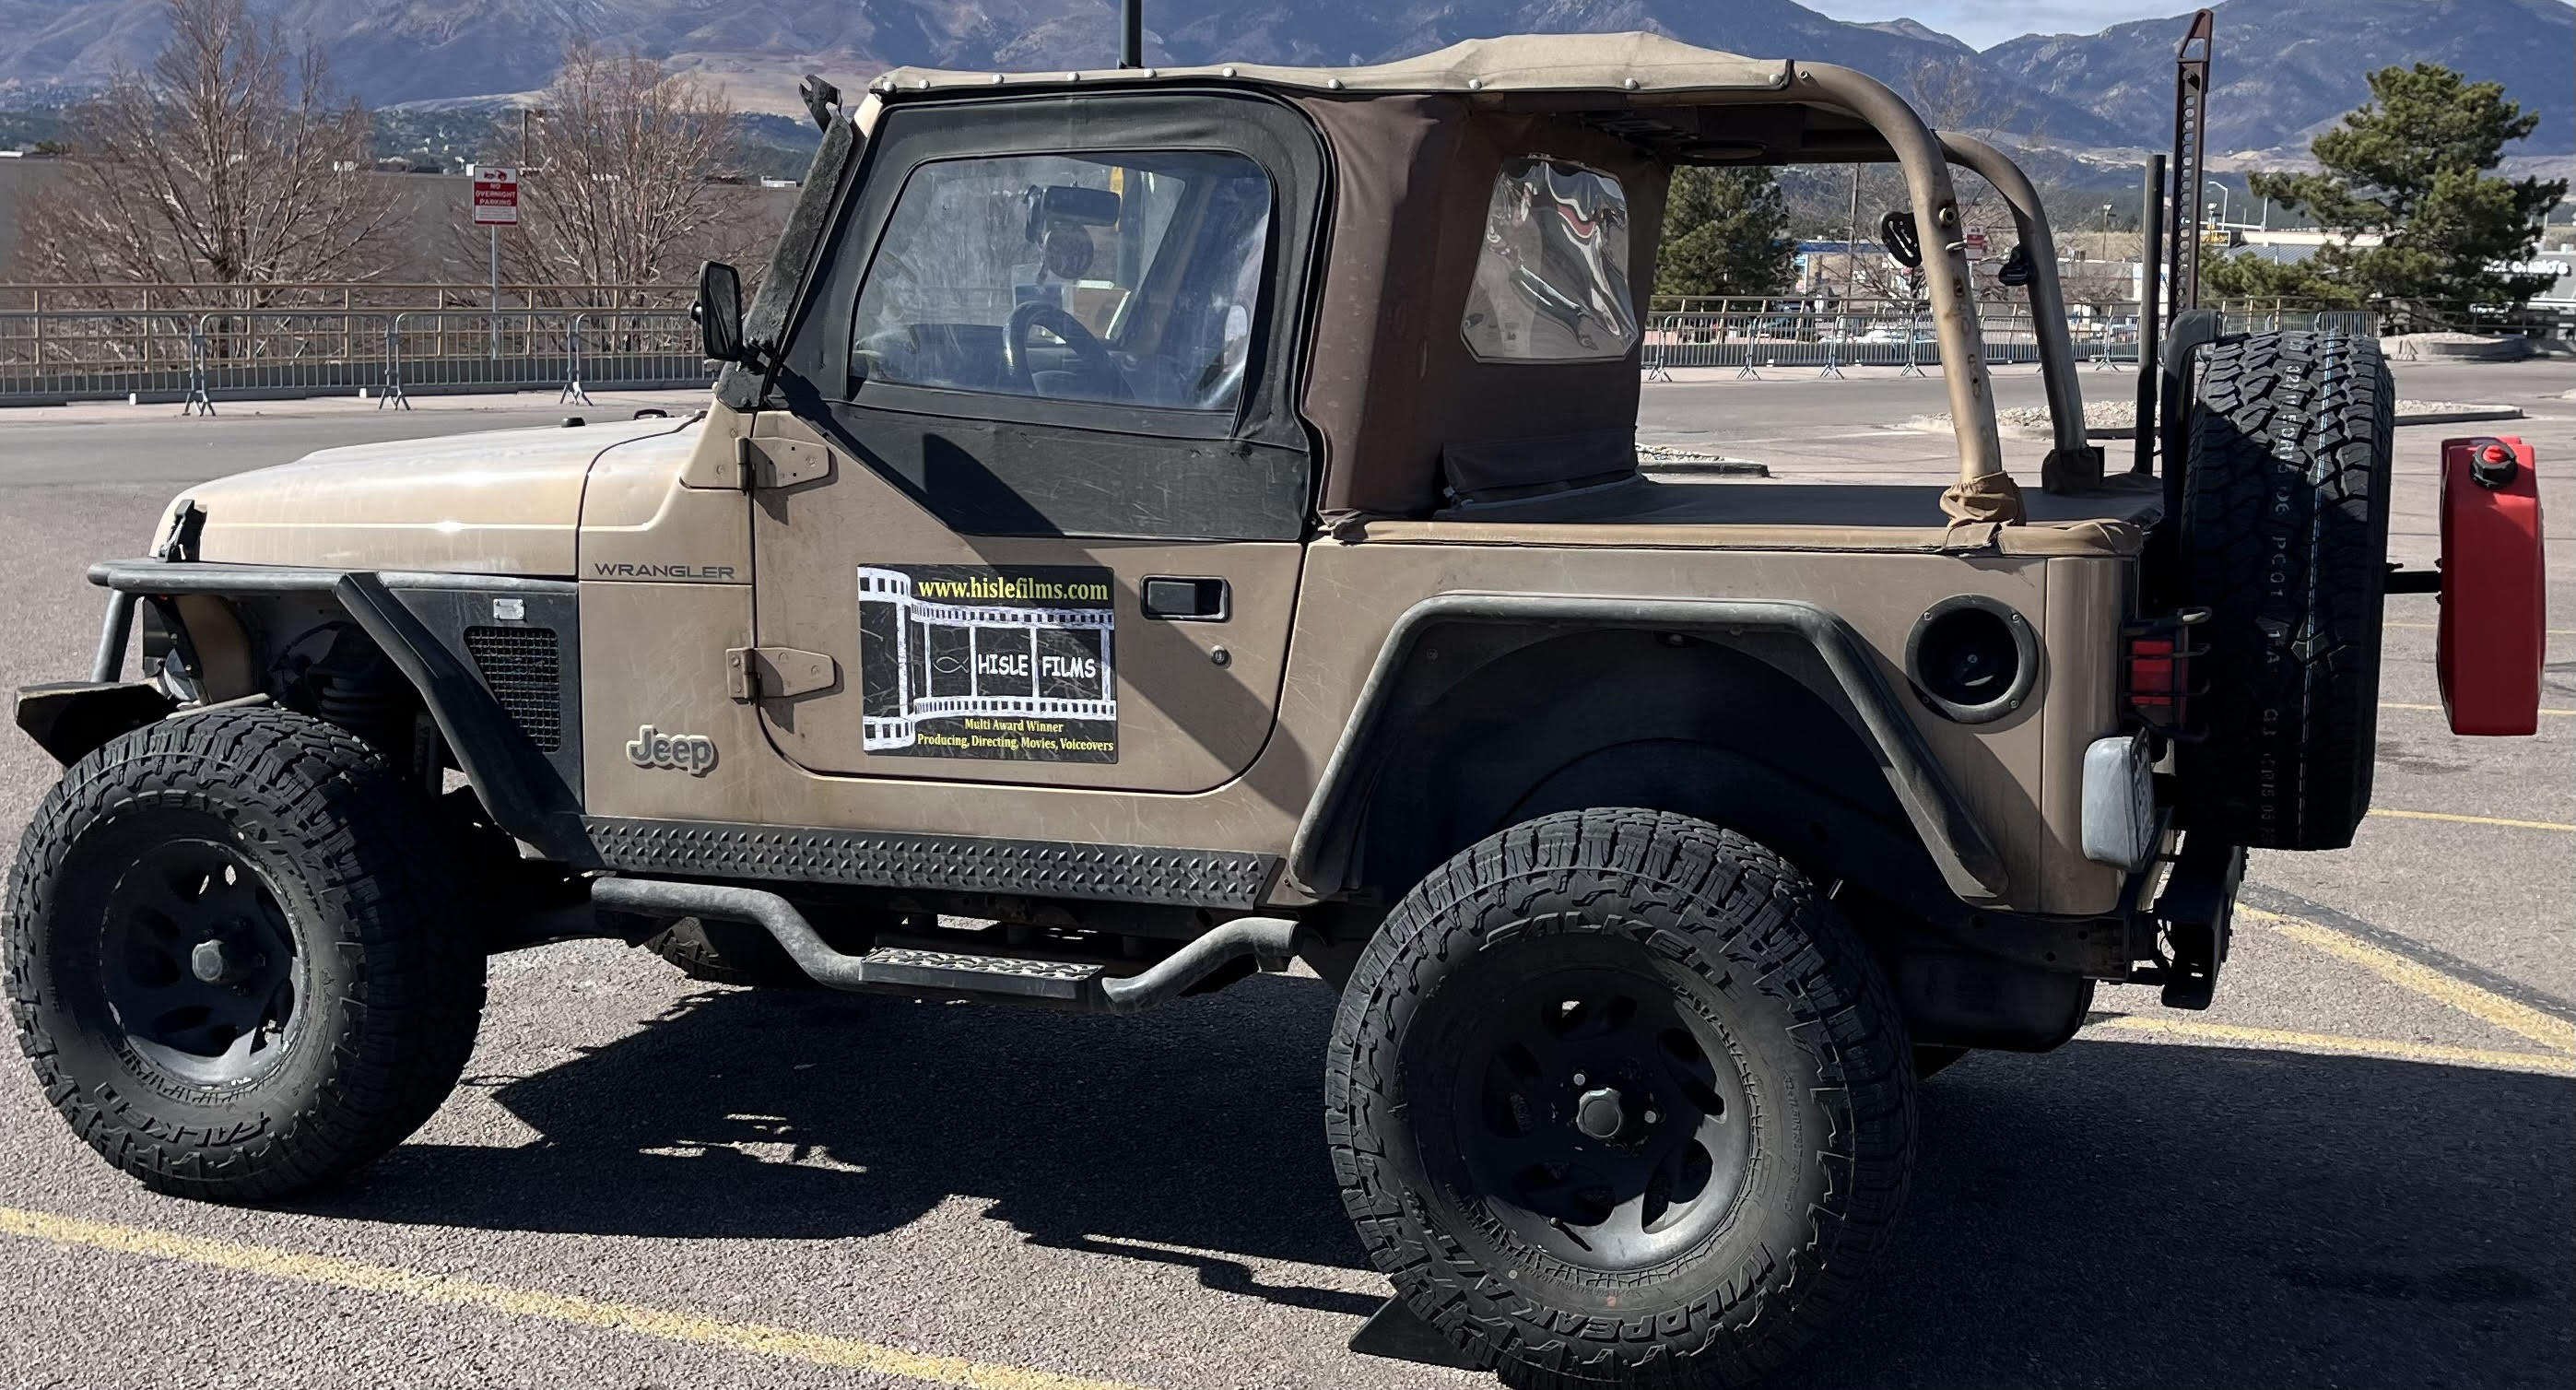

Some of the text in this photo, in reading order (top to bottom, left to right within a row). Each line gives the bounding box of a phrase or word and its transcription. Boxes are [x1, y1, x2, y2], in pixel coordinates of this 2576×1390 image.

[475, 190, 516, 198] OVERNIGHT
[594, 562, 735, 579] WRANGLER
[918, 576, 1109, 600] www.hislefilms.com
[978, 654, 1097, 678] HISLE FILMS
[964, 718, 1065, 733] Multi Award Winner
[628, 724, 714, 773] Jeep
[917, 733, 1114, 752] Producing, Directing, Movies, Voiceovers
[1478, 911, 1735, 994] FALKEN
[94, 1082, 271, 1147] FALKEN
[1509, 1241, 1777, 1344] WILDPEAK
